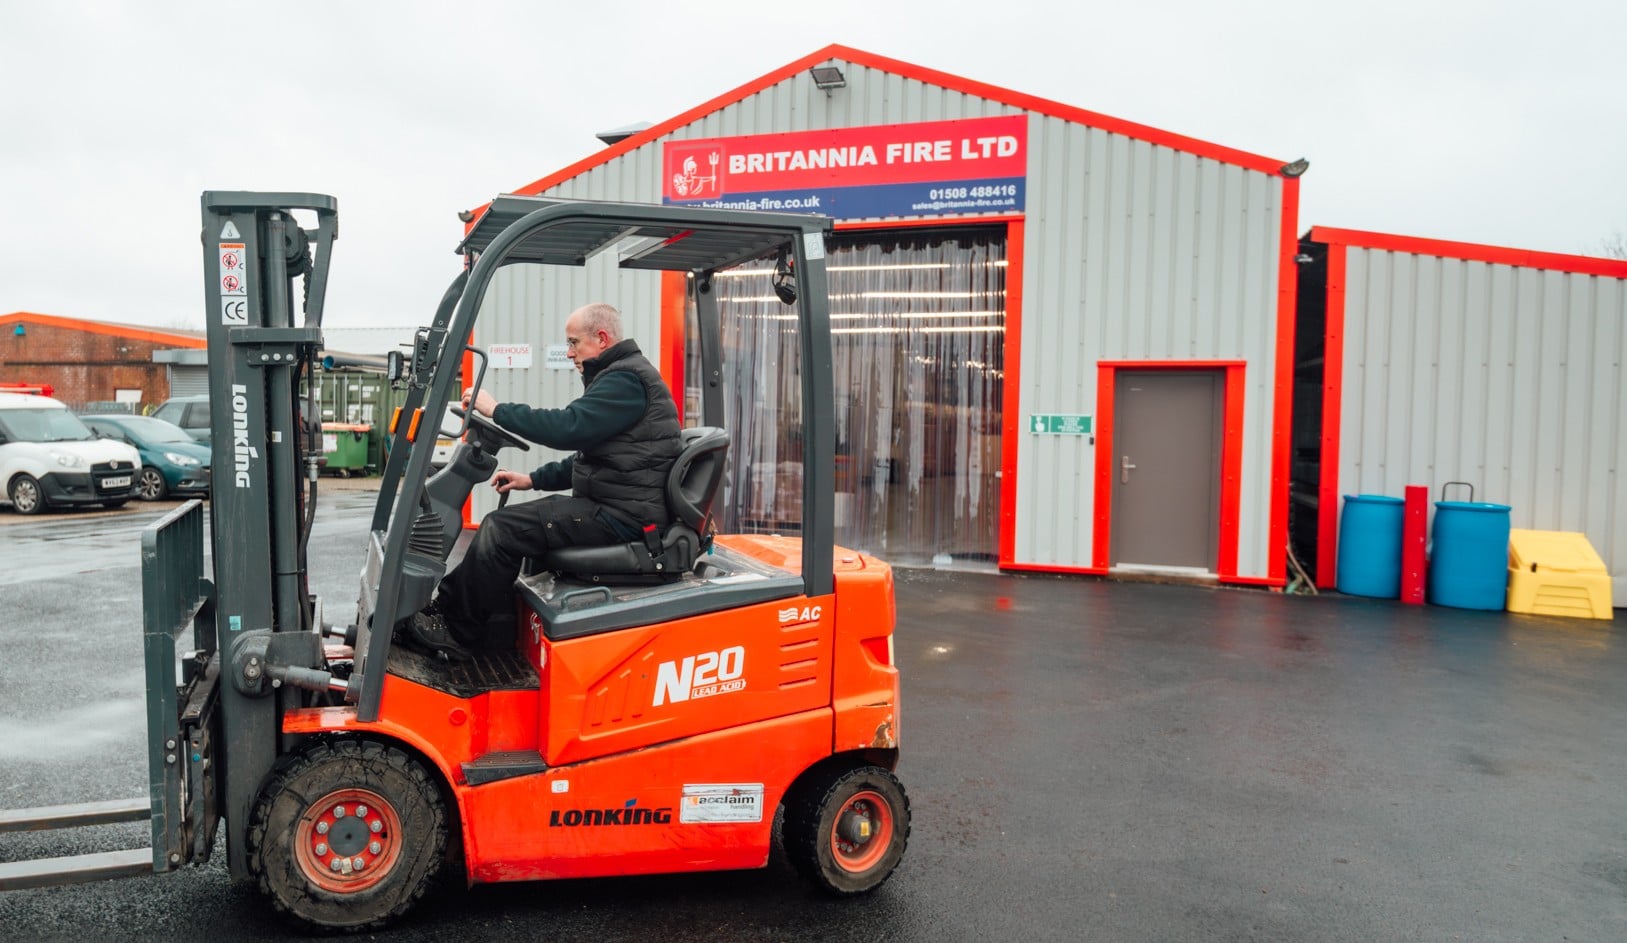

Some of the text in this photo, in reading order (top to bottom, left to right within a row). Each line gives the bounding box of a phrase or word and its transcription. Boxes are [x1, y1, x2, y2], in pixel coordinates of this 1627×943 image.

[729, 136, 1018, 174] BRITANNIA FIRE LTD
[930, 185, 1016, 200] 01508 488416
[912, 198, 1015, 210] sales@britannia-fire.co.uk
[225, 301, 245, 320] CE
[507, 356, 512, 366] 1
[800, 606, 822, 621] AC
[652, 645, 745, 707] N20
[694, 681, 743, 697] LEAD ACID
[699, 796, 754, 804] acclaim
